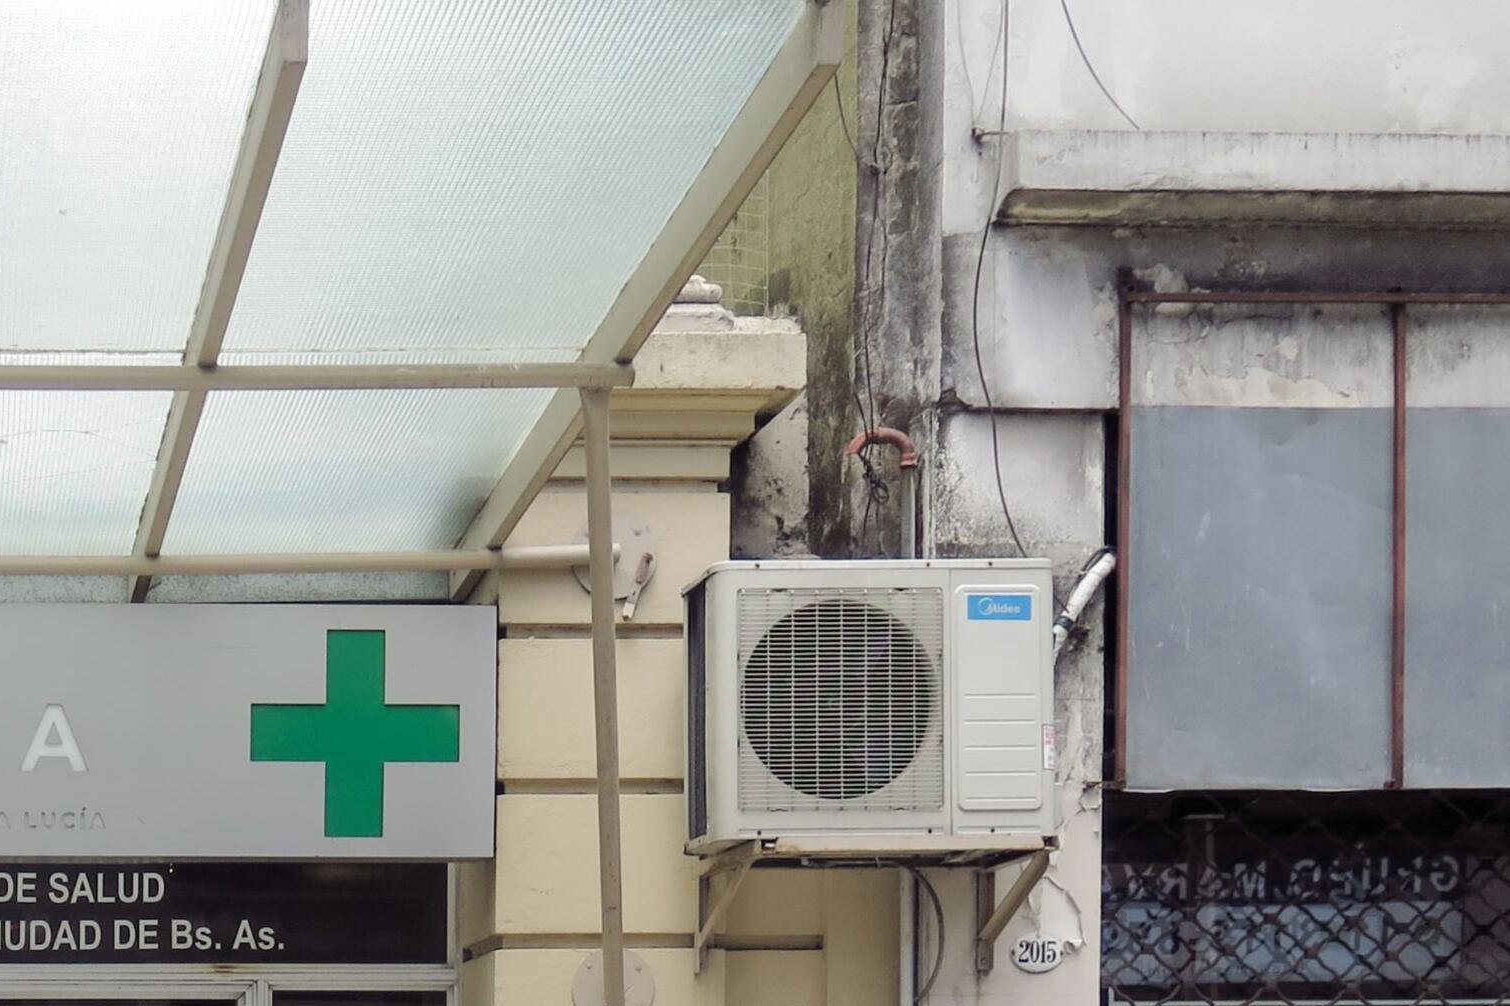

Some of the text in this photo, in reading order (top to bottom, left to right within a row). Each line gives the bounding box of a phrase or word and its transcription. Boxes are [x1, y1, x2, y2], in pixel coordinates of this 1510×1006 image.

[984, 602, 1021, 614] Midea
[23, 807, 107, 830] LUCÍA
[48, 872, 165, 904] SALUD
[113, 919, 159, 950] DE
[170, 919, 222, 950] Bs.
[232, 919, 285, 950] As.
[1018, 940, 1057, 963] 2015
